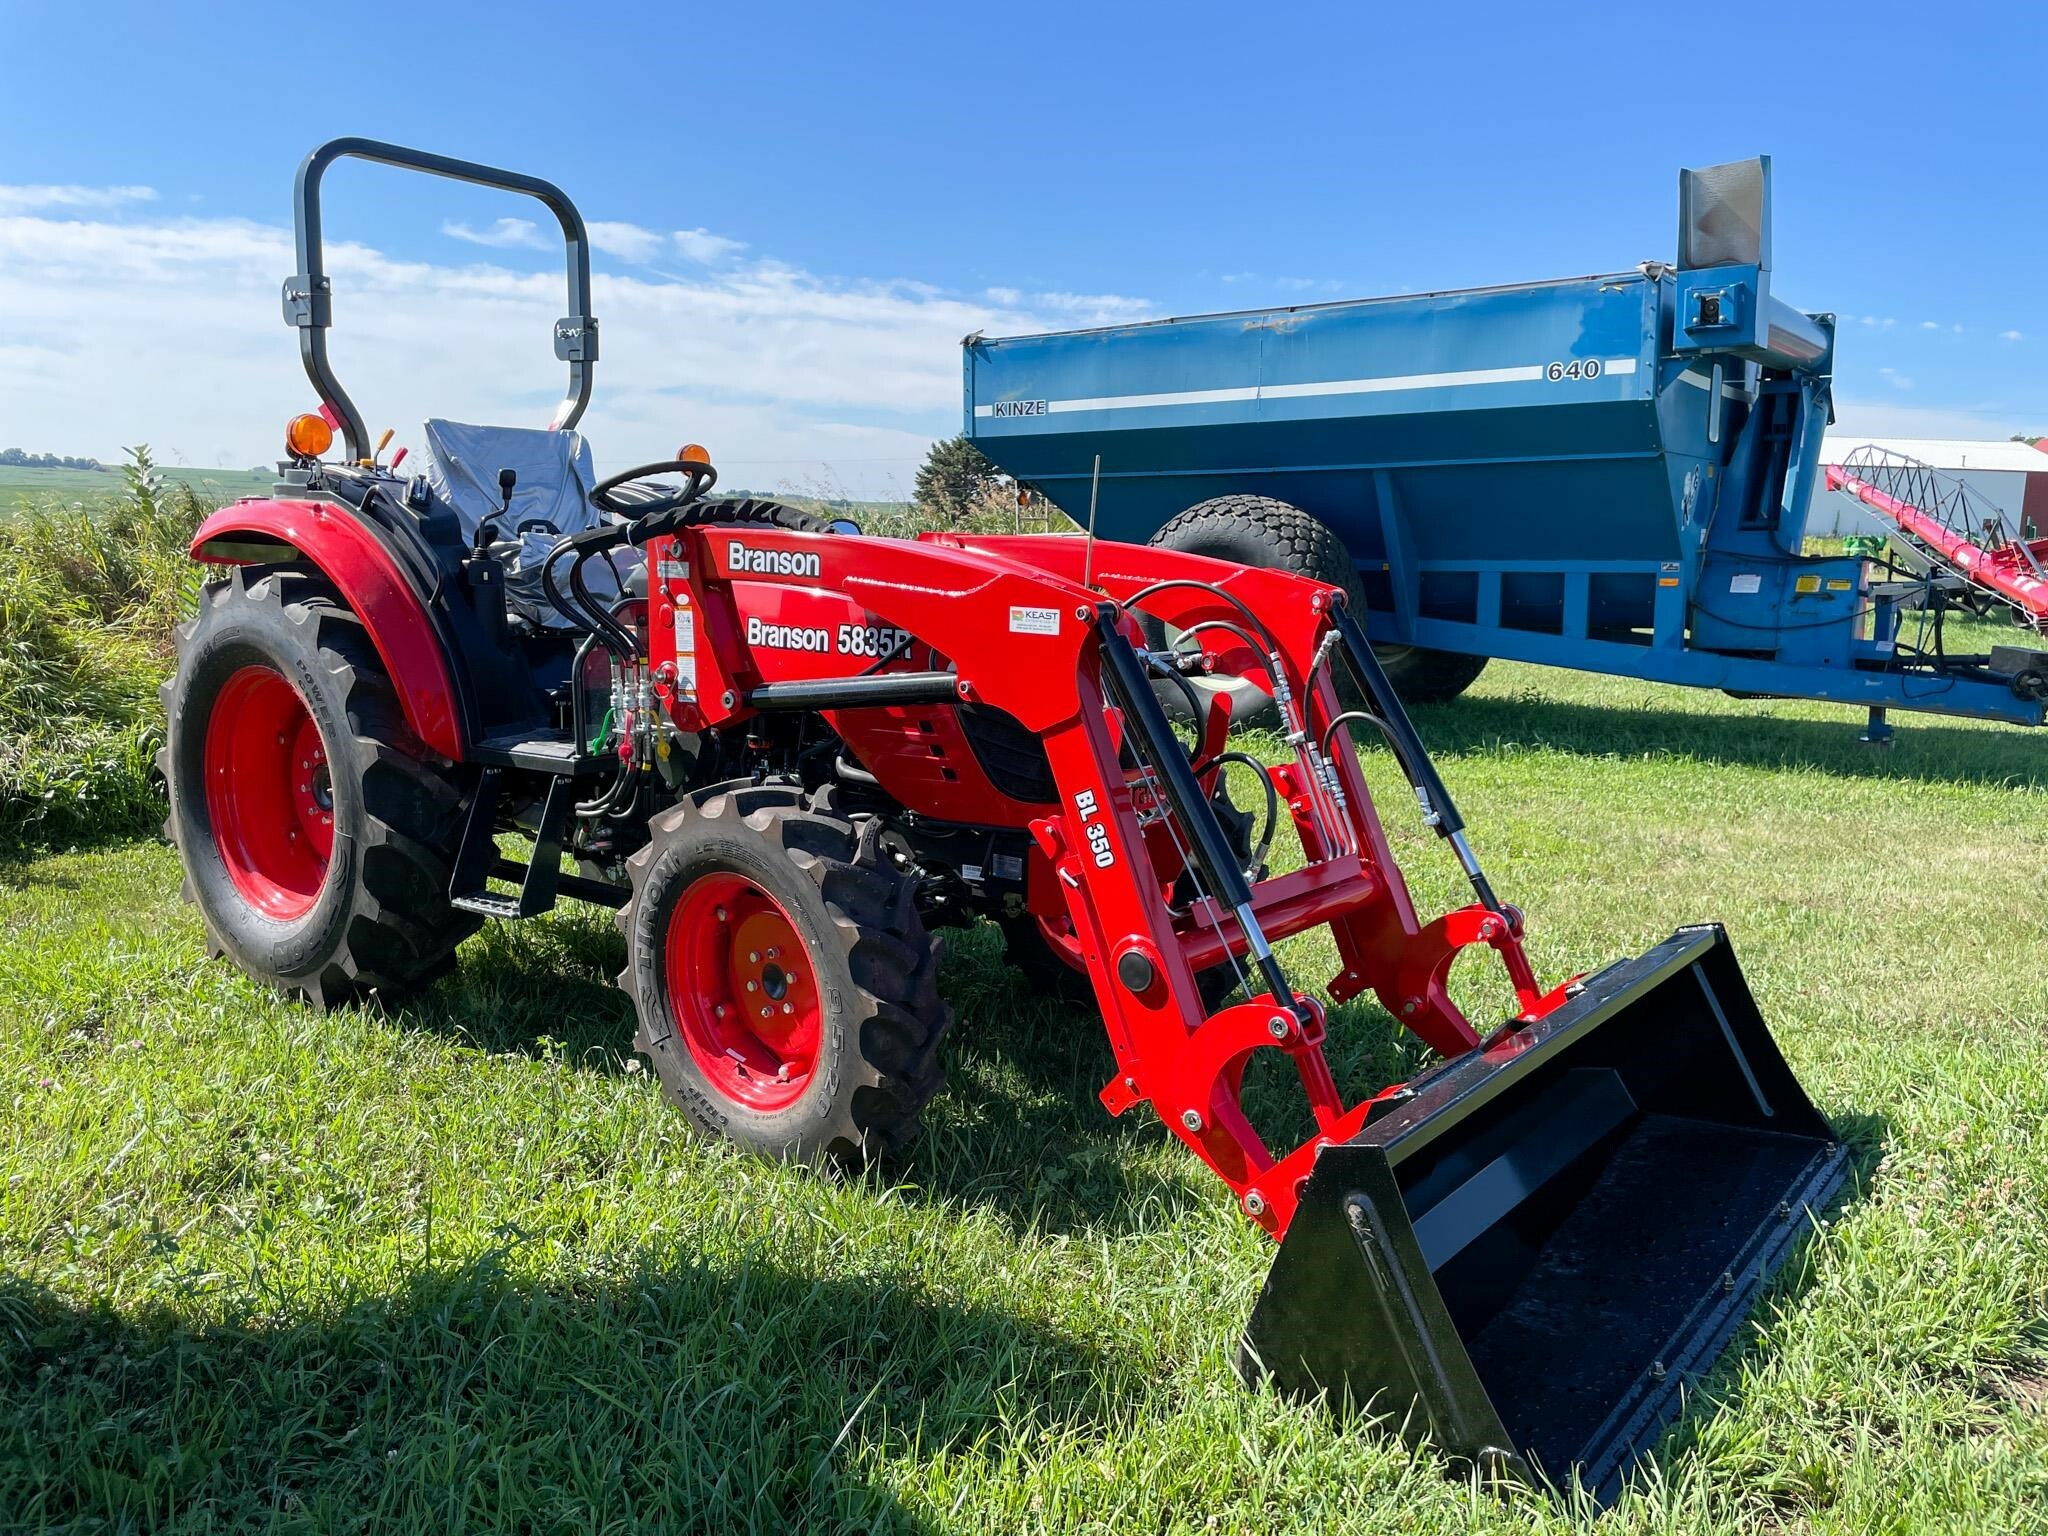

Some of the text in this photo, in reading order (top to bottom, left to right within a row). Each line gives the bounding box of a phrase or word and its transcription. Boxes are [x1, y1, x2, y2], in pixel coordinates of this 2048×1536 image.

[1548, 360, 1600, 381] 640
[995, 400, 1045, 418] KINZE
[728, 541, 820, 577] Branson
[1025, 611, 1058, 620] KEAST
[747, 617, 912, 659] Branson 5835R
[296, 659, 336, 738] POWER
[1074, 789, 1115, 868] BL 350
[637, 858, 680, 975] TIRON
[816, 988, 844, 1118] 9.5-20
[688, 1087, 729, 1127] GRIP
